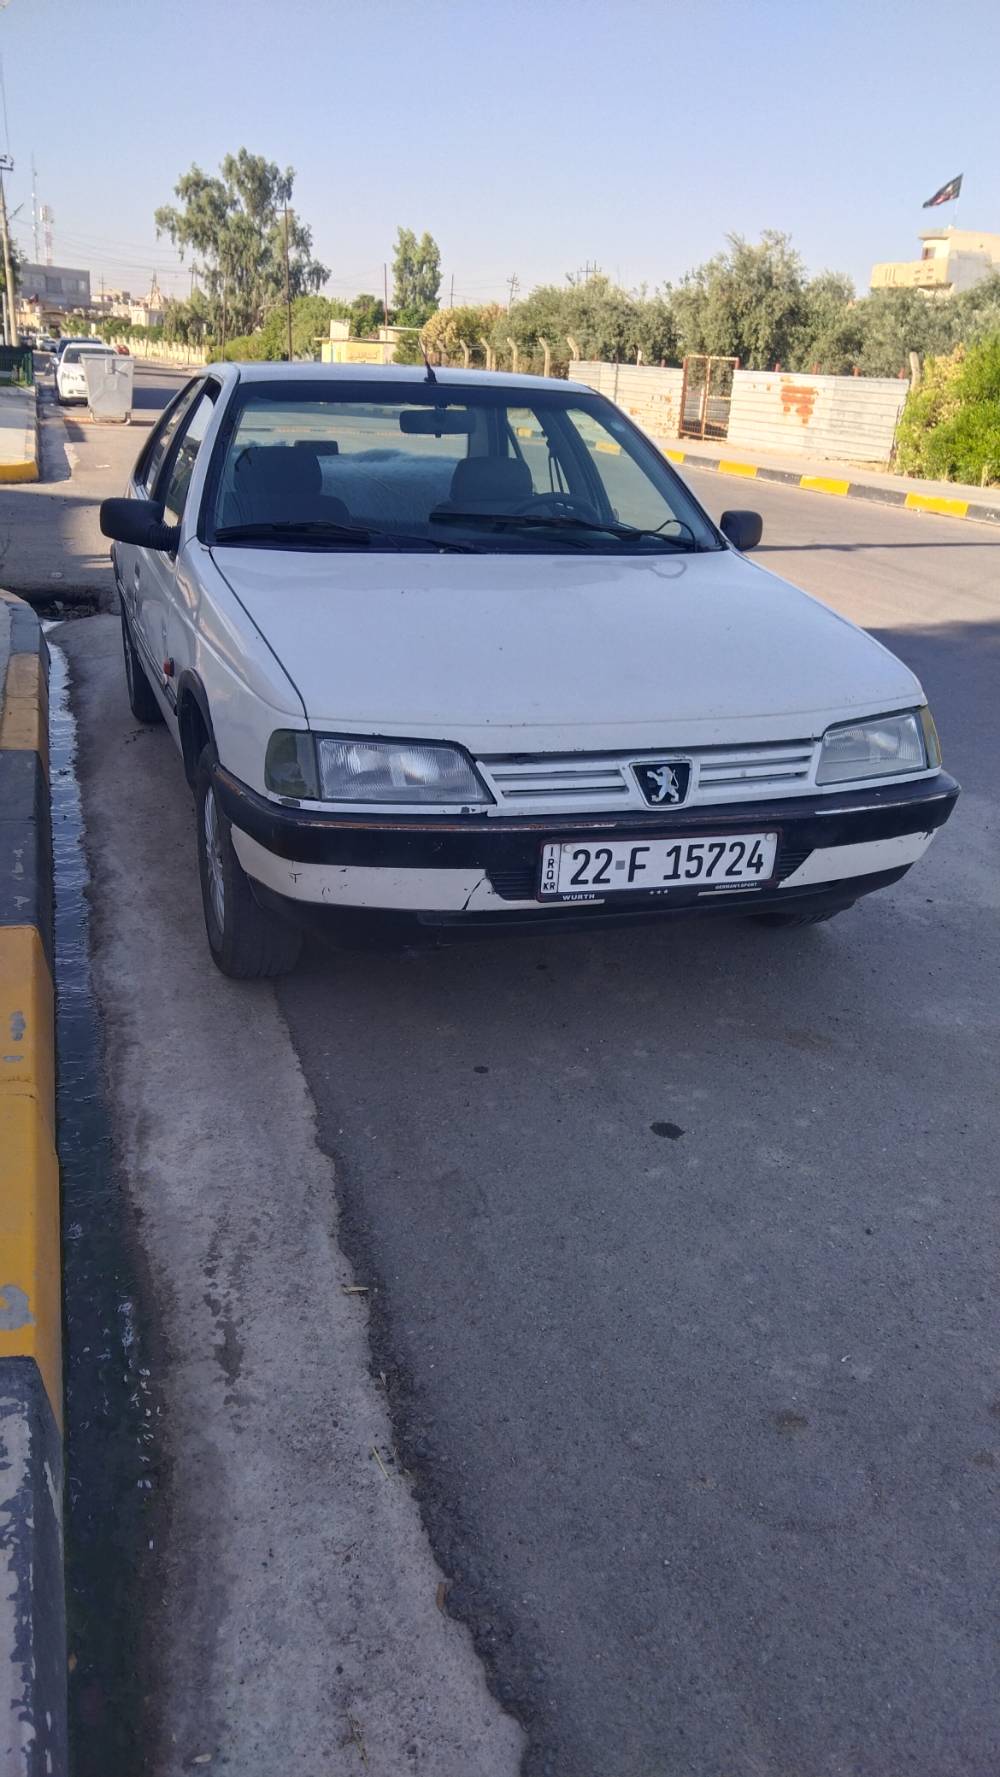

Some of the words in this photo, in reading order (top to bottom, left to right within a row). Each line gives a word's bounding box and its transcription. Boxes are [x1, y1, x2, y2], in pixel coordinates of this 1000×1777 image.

[570, 848, 612, 885] 22
[627, 846, 650, 883] F
[663, 839, 764, 881] 15724
